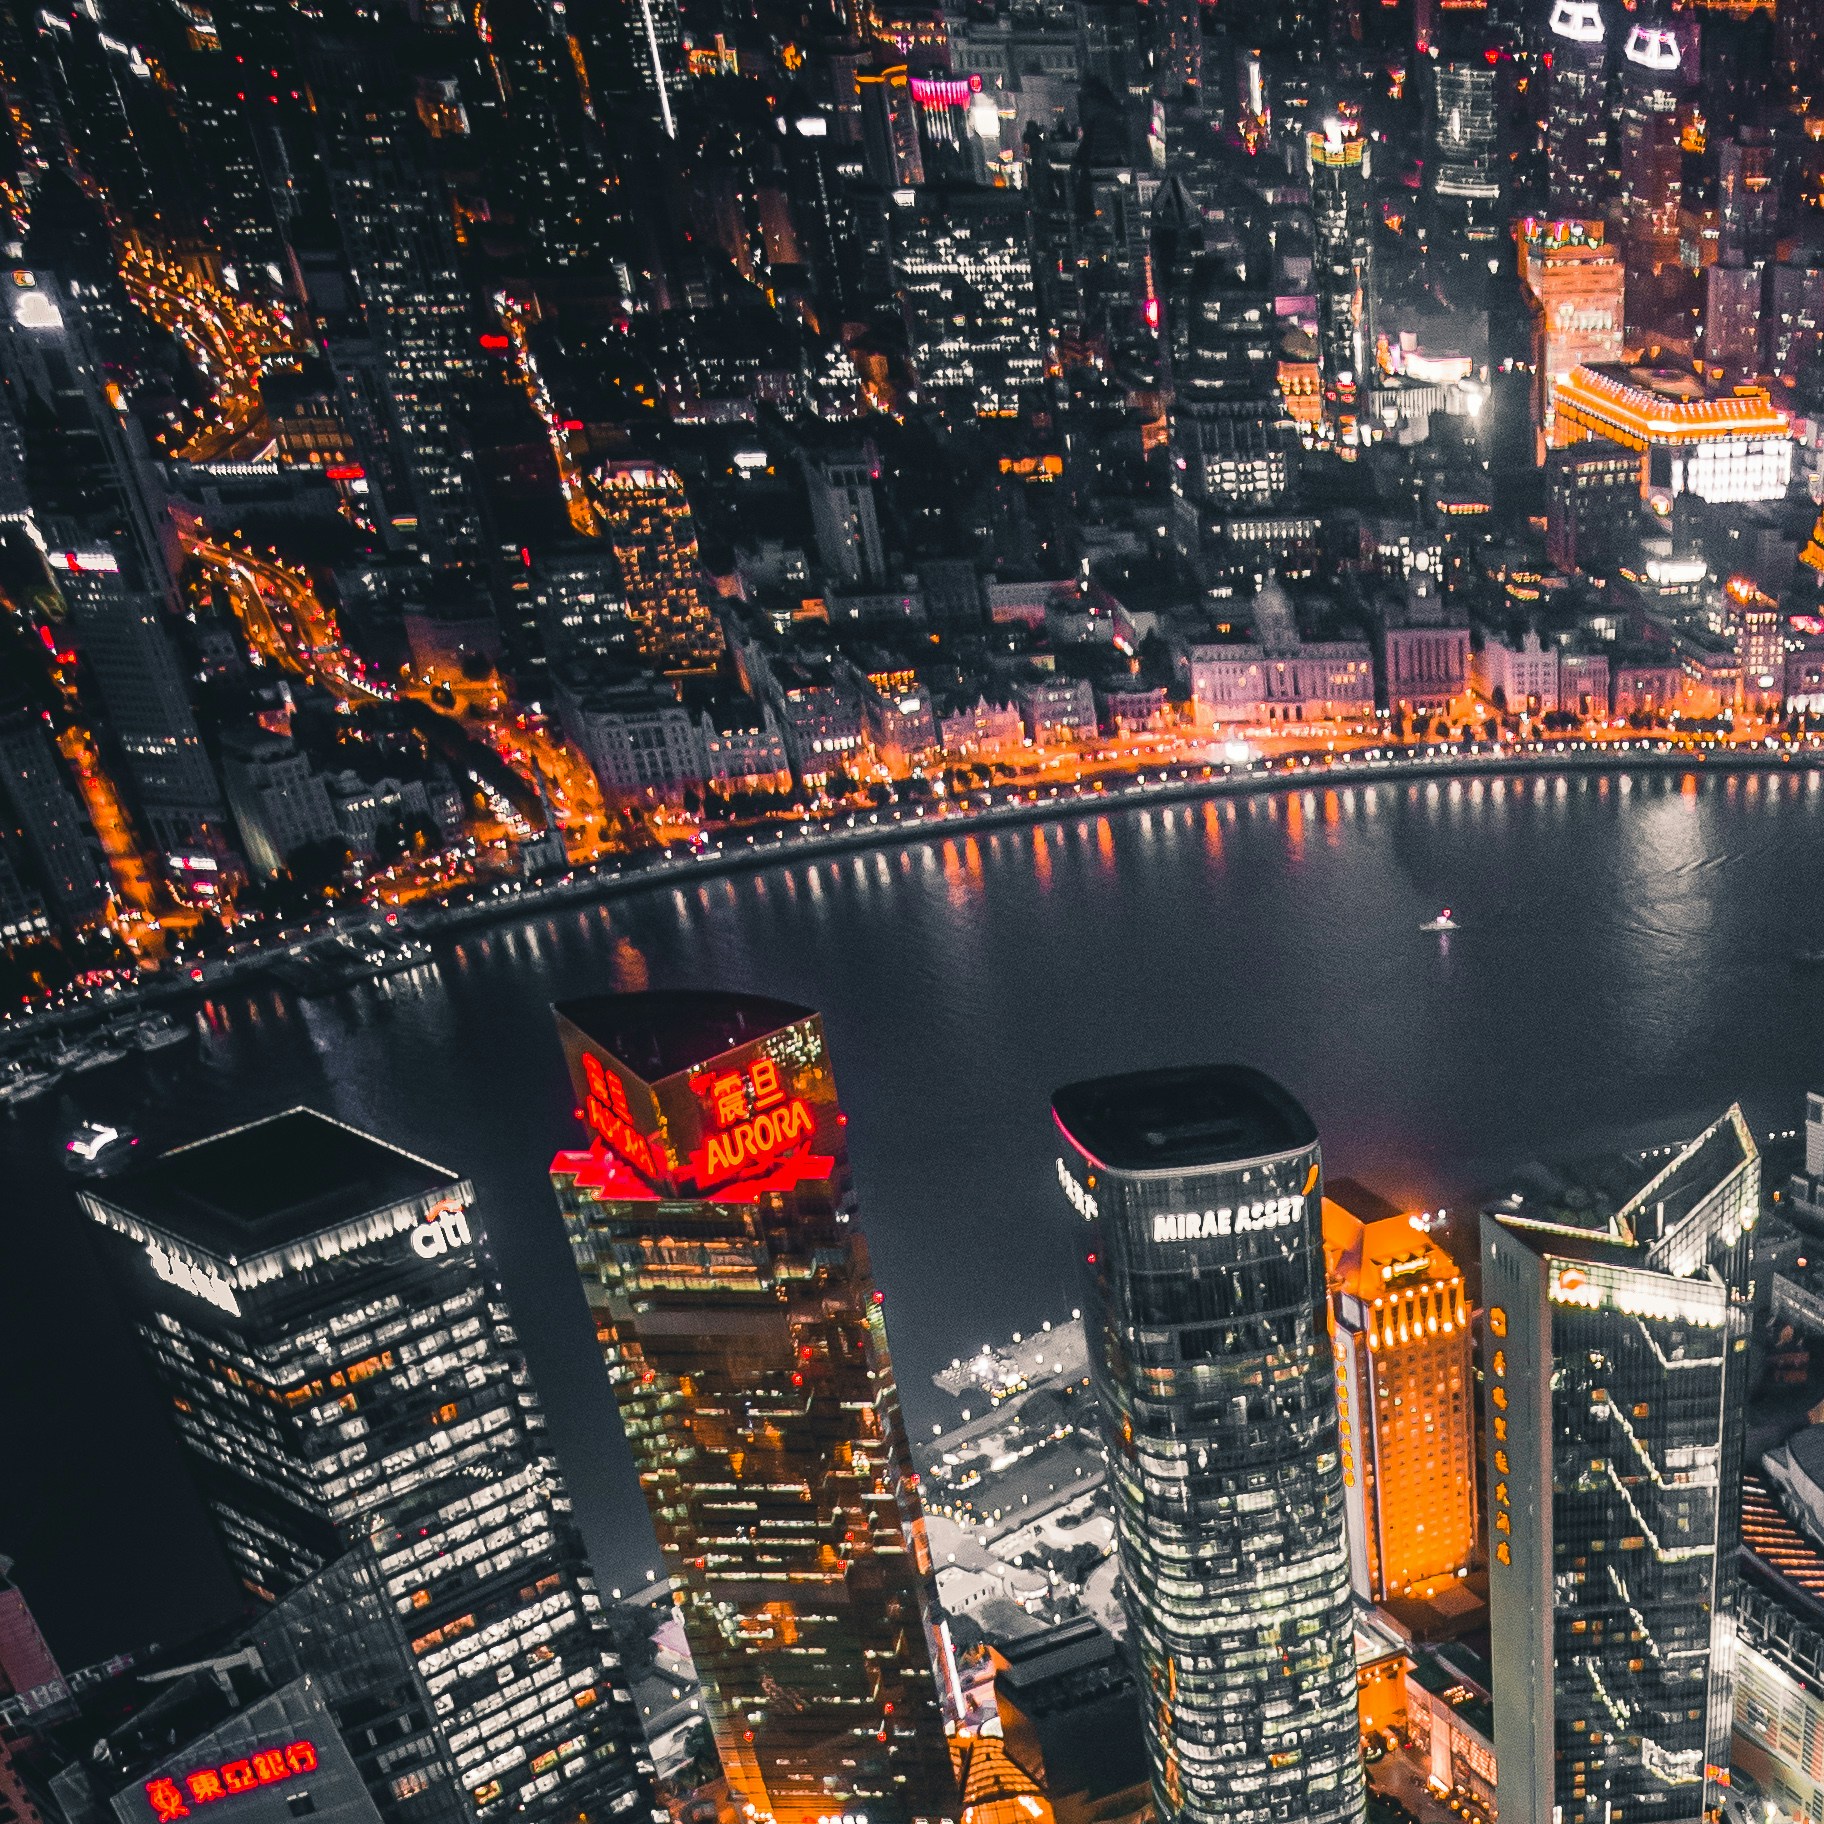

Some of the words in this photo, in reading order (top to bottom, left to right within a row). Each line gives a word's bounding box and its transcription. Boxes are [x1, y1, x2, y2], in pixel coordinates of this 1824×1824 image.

[712, 1056, 785, 1125] 震旦
[706, 1101, 813, 1175] AURORA
[1153, 1208, 1232, 1242] MIRAE
[1234, 1195, 1305, 1234] ASSET
